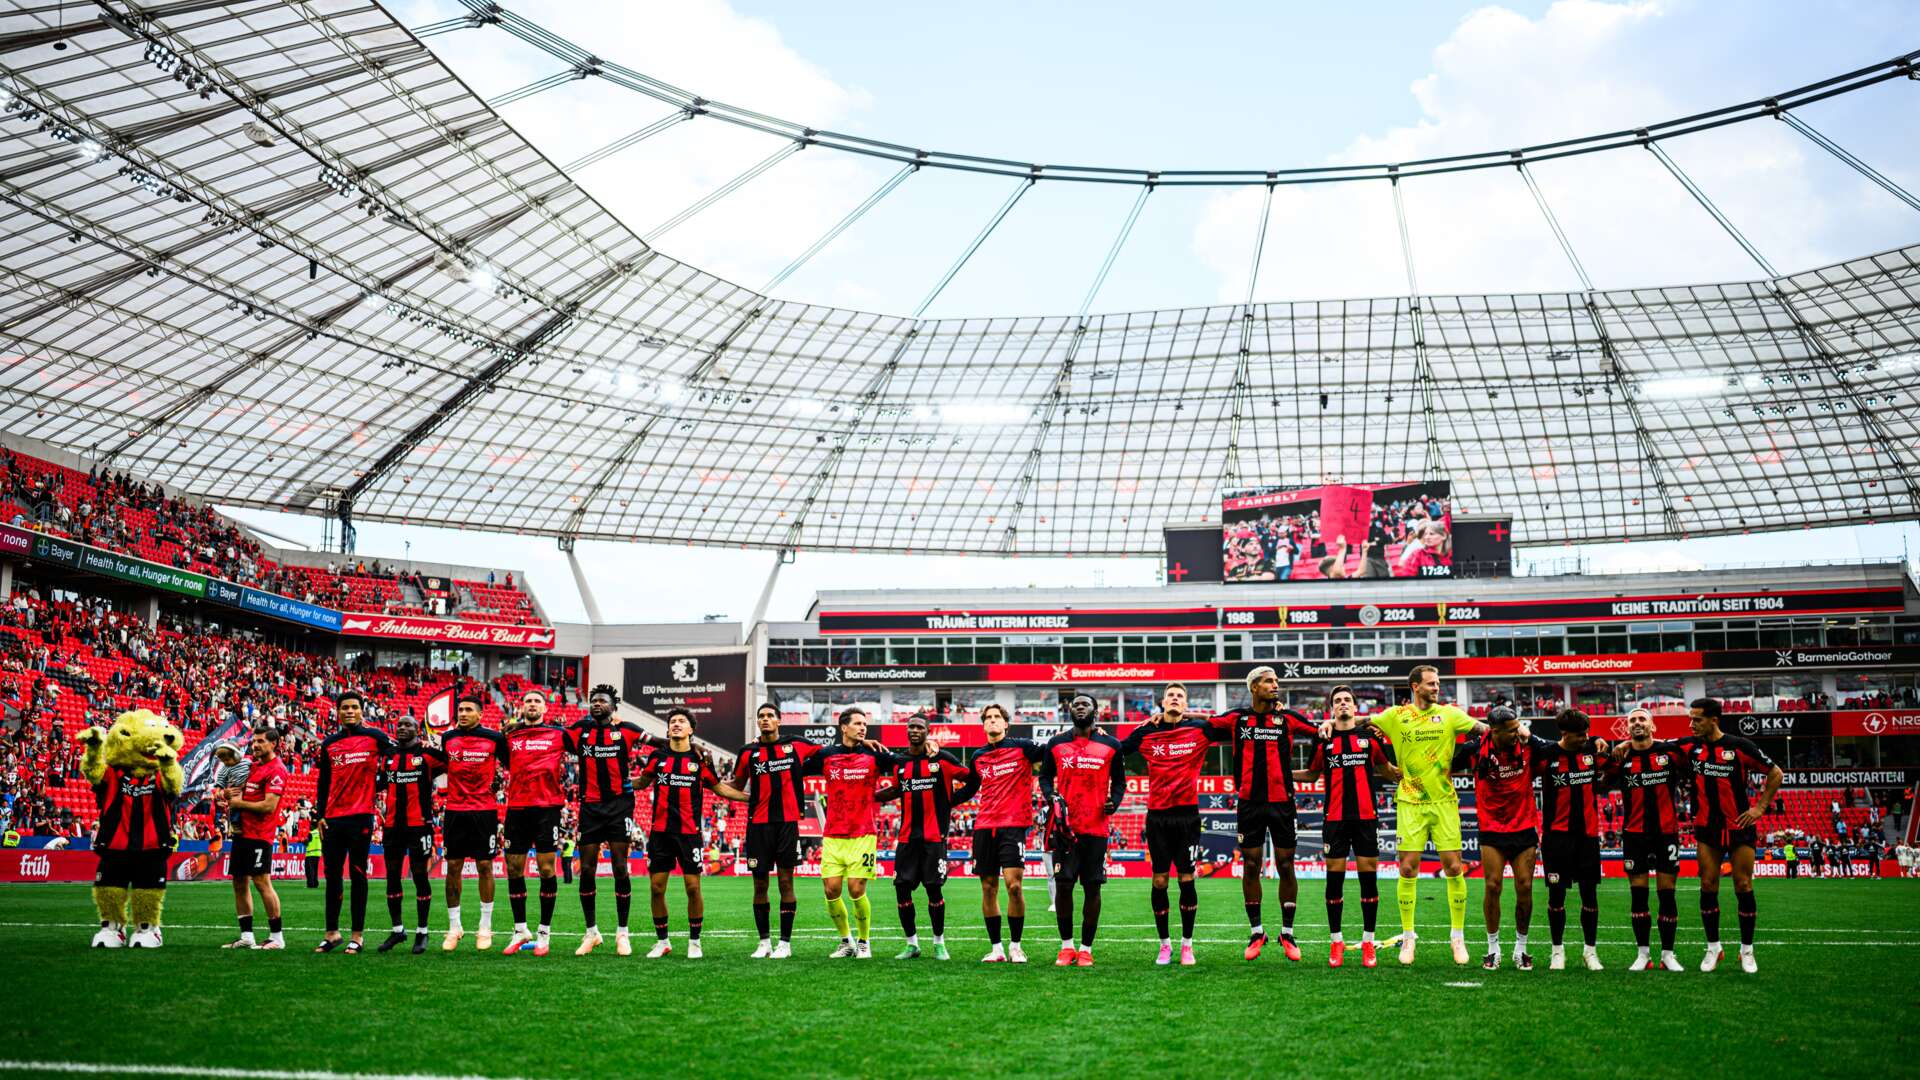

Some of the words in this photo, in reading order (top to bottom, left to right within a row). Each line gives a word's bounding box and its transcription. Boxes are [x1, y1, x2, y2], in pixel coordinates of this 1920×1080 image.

[1238, 494, 1298, 506] FANWELT
[4, 533, 28, 548] none
[51, 544, 74, 560] Bayer
[86, 554, 114, 570] Health
[116, 560, 129, 572] for
[129, 564, 141, 578] all,
[142, 568, 170, 584] Hunger
[172, 574, 182, 586] for
[184, 580, 202, 591] none
[1422, 566, 1450, 576] 17:24
[220, 586, 238, 600] Bayer
[247, 594, 268, 608] Health
[269, 600, 278, 610] for
[290, 603, 312, 618] Hunger
[312, 608, 321, 620] for
[322, 614, 336, 624] none
[1612, 602, 1649, 615] KEINE
[1652, 599, 1720, 614] TRADITION
[1722, 598, 1750, 610] SEIT
[1753, 597, 1784, 610] 1904
[1226, 612, 1254, 624] 1988
[1290, 611, 1318, 623] 1993
[1384, 608, 1414, 621] 2024
[1449, 607, 1480, 620] 2024
[926, 613, 976, 629] TRÄUME
[978, 616, 1030, 629] UNTERM
[1032, 615, 1069, 628] KREUZ
[372, 619, 489, 640] Anheuser-Busch
[490, 628, 526, 643] Bud
[1798, 651, 1892, 663] BarmeniaGothaer
[1304, 664, 1389, 676] BarmeniaGothaer
[1544, 658, 1632, 670] BarmeniaGothaer
[844, 668, 927, 681] BarmeniaGothaer
[1071, 667, 1155, 680] BarmeniaGothaer
[1762, 718, 1794, 728] KKV
[804, 729, 825, 738] pure
[1704, 762, 1734, 771] Barmenia
[1704, 769, 1730, 777] Gothaer
[670, 773, 696, 781] Barmenia
[1641, 770, 1669, 778] Barmenia
[1799, 774, 1807, 784] &
[1810, 771, 1905, 784] DURCHSTARTEN!
[1642, 778, 1667, 786] Gothaer
[420, 834, 432, 849] 19
[489, 834, 496, 848] 6
[20, 854, 50, 876] früh
[862, 853, 874, 867] 28
